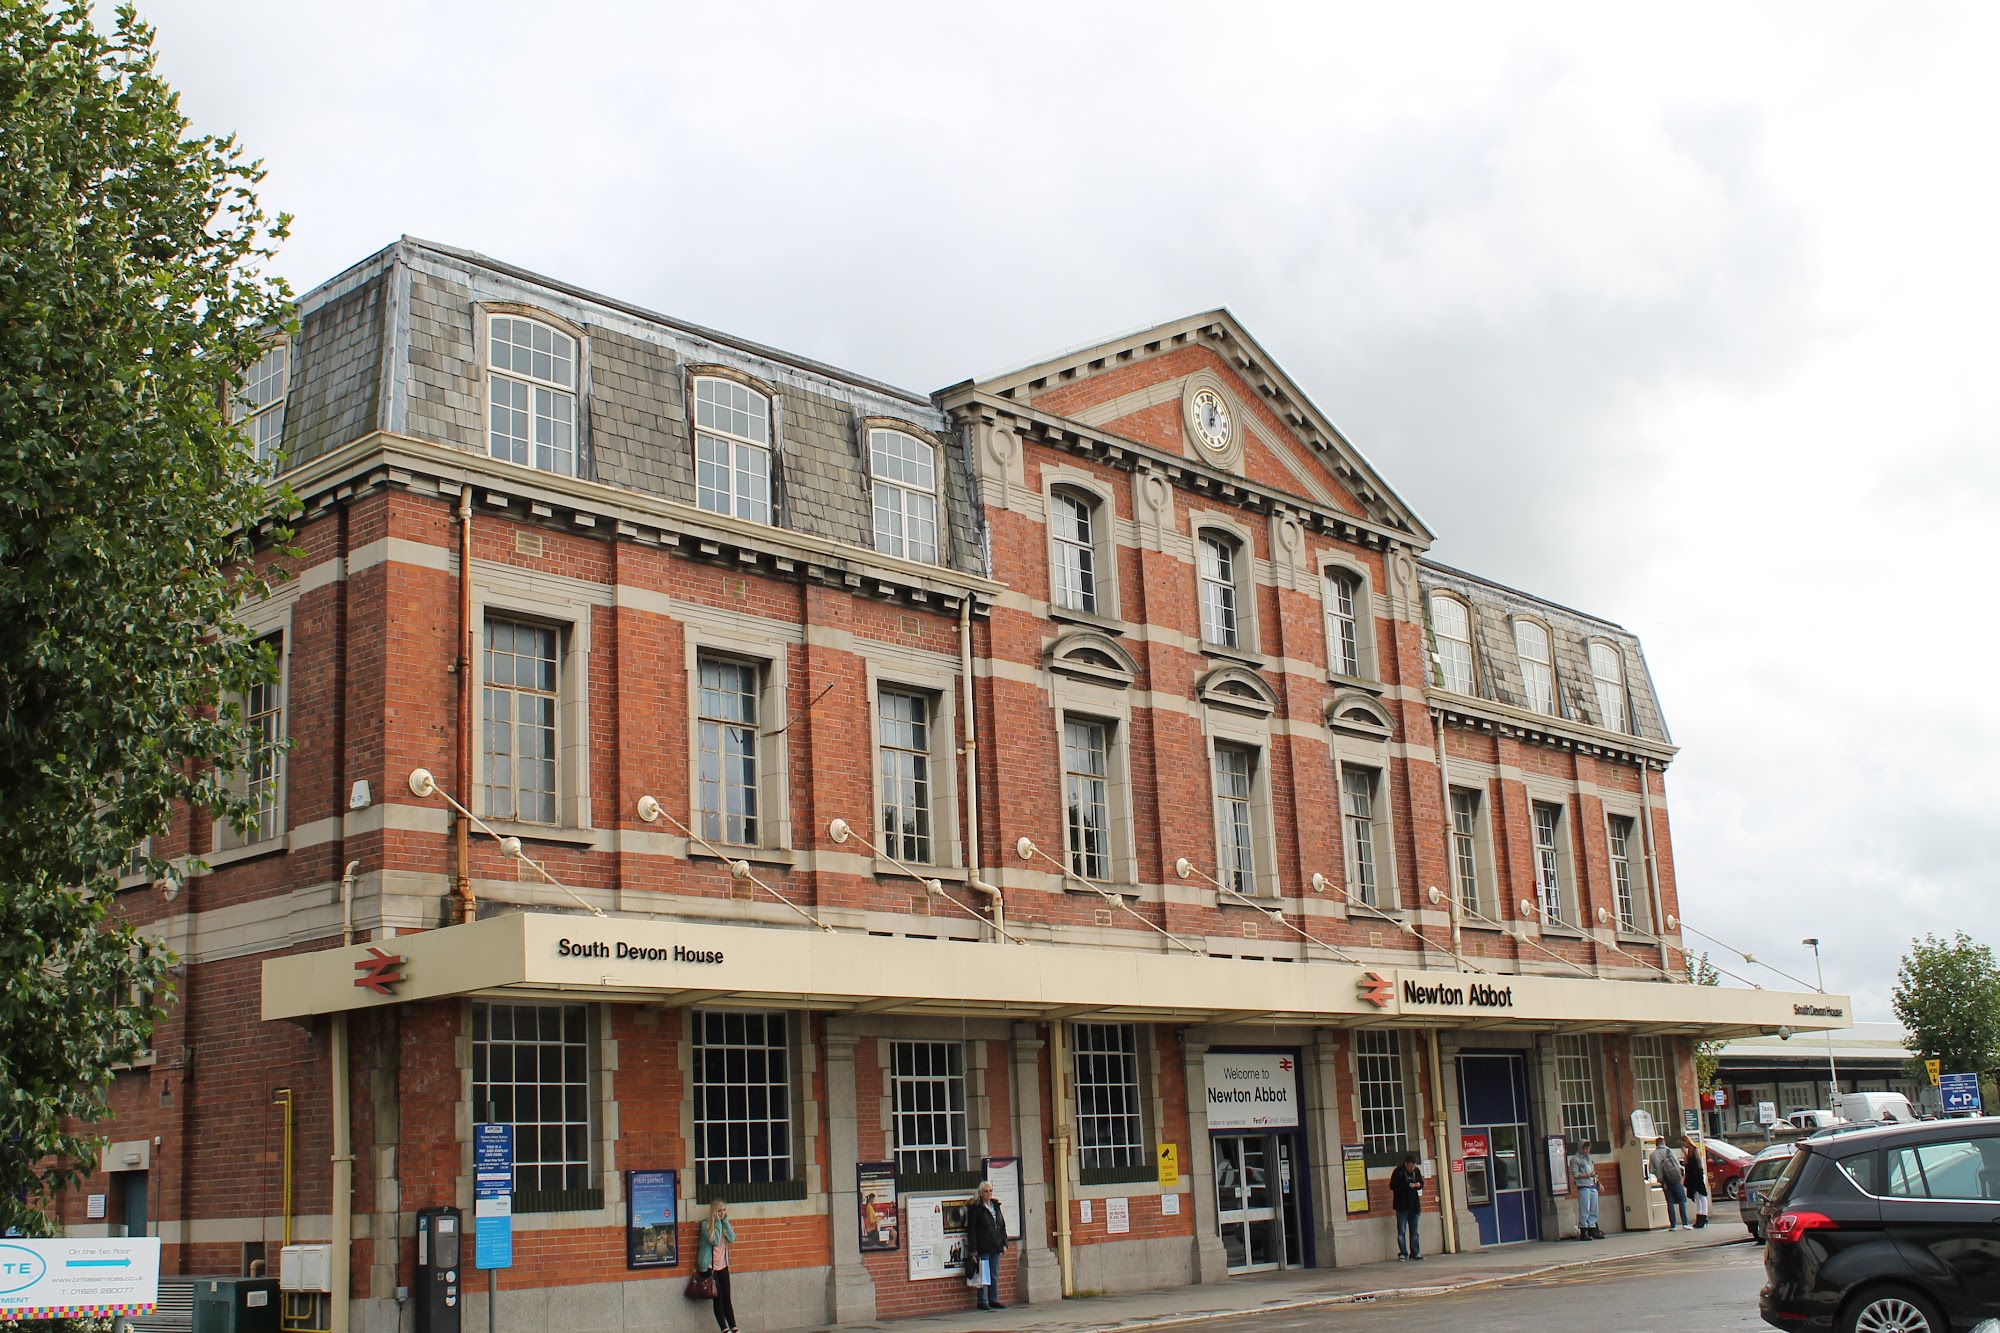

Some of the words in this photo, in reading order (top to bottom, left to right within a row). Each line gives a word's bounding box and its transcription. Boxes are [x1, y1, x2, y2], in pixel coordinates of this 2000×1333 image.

[558, 938, 610, 958] South
[616, 942, 668, 960] Devon
[674, 945, 724, 964] House
[1403, 979, 1464, 1005] Newton
[1469, 983, 1513, 1007] Abbot
[1793, 1003, 1809, 1015] South
[1809, 1005, 1826, 1016] Devon
[1826, 1006, 1843, 1017] House
[1223, 1067, 1260, 1080] Welcome
[1262, 1068, 1270, 1080] to
[1208, 1087, 1251, 1103] Newton
[1254, 1086, 1287, 1103] Abbot
[1962, 1093, 1972, 1105] P
[420, 1218, 426, 1230] P
[51, 1275, 144, 1284] www.briteservices.co.uk
[100, 1287, 135, 1295] 280077
